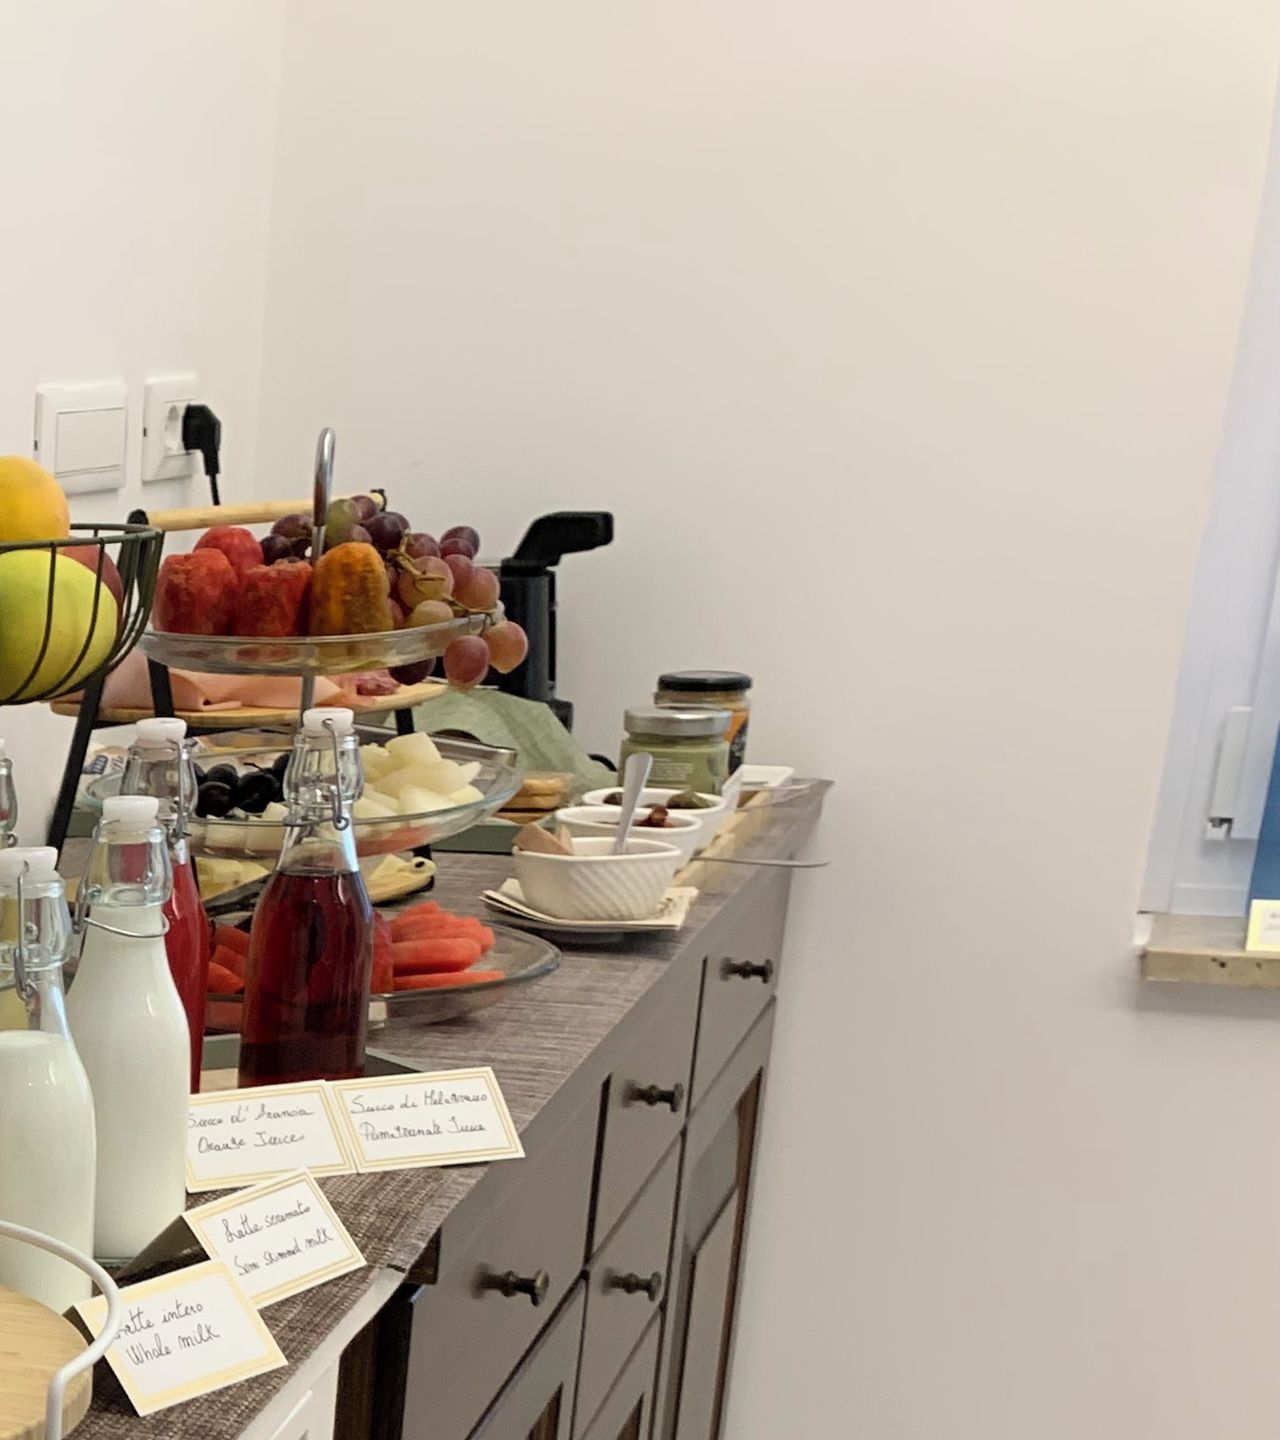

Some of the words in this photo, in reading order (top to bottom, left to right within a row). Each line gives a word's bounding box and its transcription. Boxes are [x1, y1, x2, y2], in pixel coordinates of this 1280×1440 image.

[350, 1094, 395, 1114] Succo
[305, 1226, 334, 1249] milk
[161, 1299, 204, 1324] intero
[126, 1332, 172, 1366] Whole
[177, 1322, 221, 1350] milk
